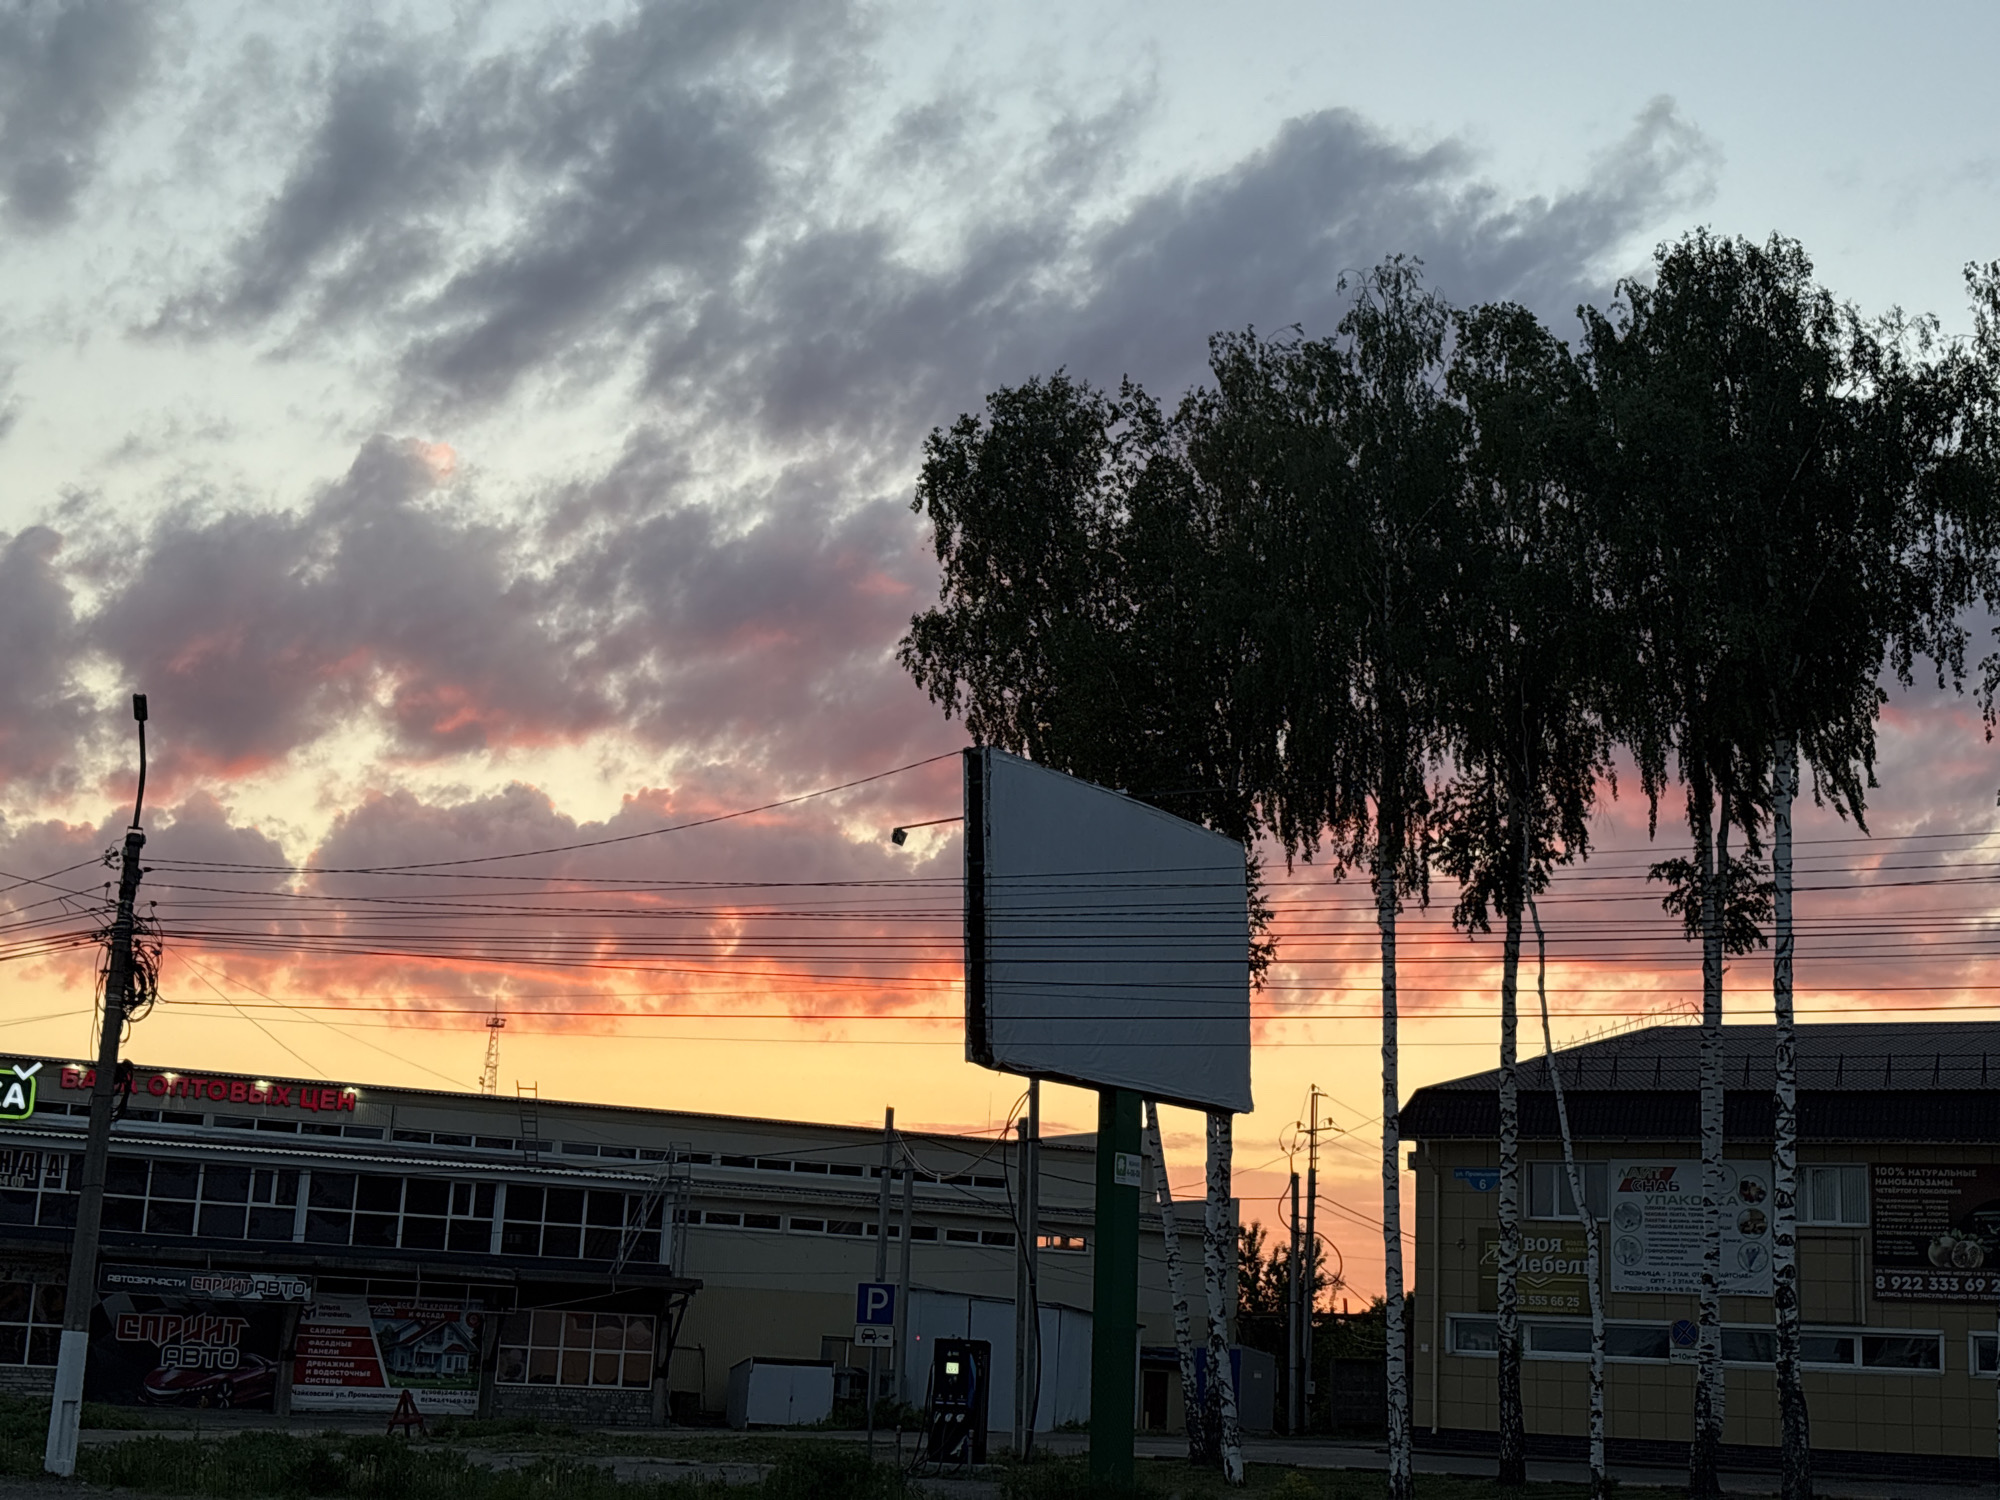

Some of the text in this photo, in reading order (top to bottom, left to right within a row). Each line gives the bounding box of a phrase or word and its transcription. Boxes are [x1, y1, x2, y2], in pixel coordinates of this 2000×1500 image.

[147, 1074, 292, 1107] ОПТОВЫХ
[299, 1087, 356, 1112] ЦЕН
[1875, 1167, 1977, 1177] 100% НАТУРАЛЬНЫЕ
[1479, 1179, 1487, 1190] 6
[1875, 1178, 1954, 1187] НАНОБАЛЬЗАМЫ
[107, 1274, 307, 1296] АВТОЗАПЧАСТИ СПРИНТ АВТО
[1875, 1275, 1886, 1290] 8
[1890, 1276, 1924, 1291] 922
[1928, 1277, 1960, 1292] 333
[1964, 1278, 1987, 1293] 69
[866, 1287, 889, 1321] P
[1528, 1295, 1548, 1306] 555
[1550, 1296, 1564, 1307] 66
[1566, 1297, 1580, 1308] 25
[416, 1311, 446, 1319] ФАСАДА
[115, 1311, 251, 1349] СПРИНТ
[309, 1327, 347, 1335] САЙДИНГ
[308, 1340, 353, 1348] ФАСАДНЫЕ
[307, 1348, 340, 1356] ПАНЕЛИ
[160, 1344, 240, 1370] АВТО
[306, 1360, 355, 1368] ДРЕНАЖНАЯ
[313, 1369, 371, 1378] ВОДОСТОЧНЫЕ
[304, 1377, 343, 1385] СИСТЕМЫ
[292, 1389, 335, 1397] Чайковский
